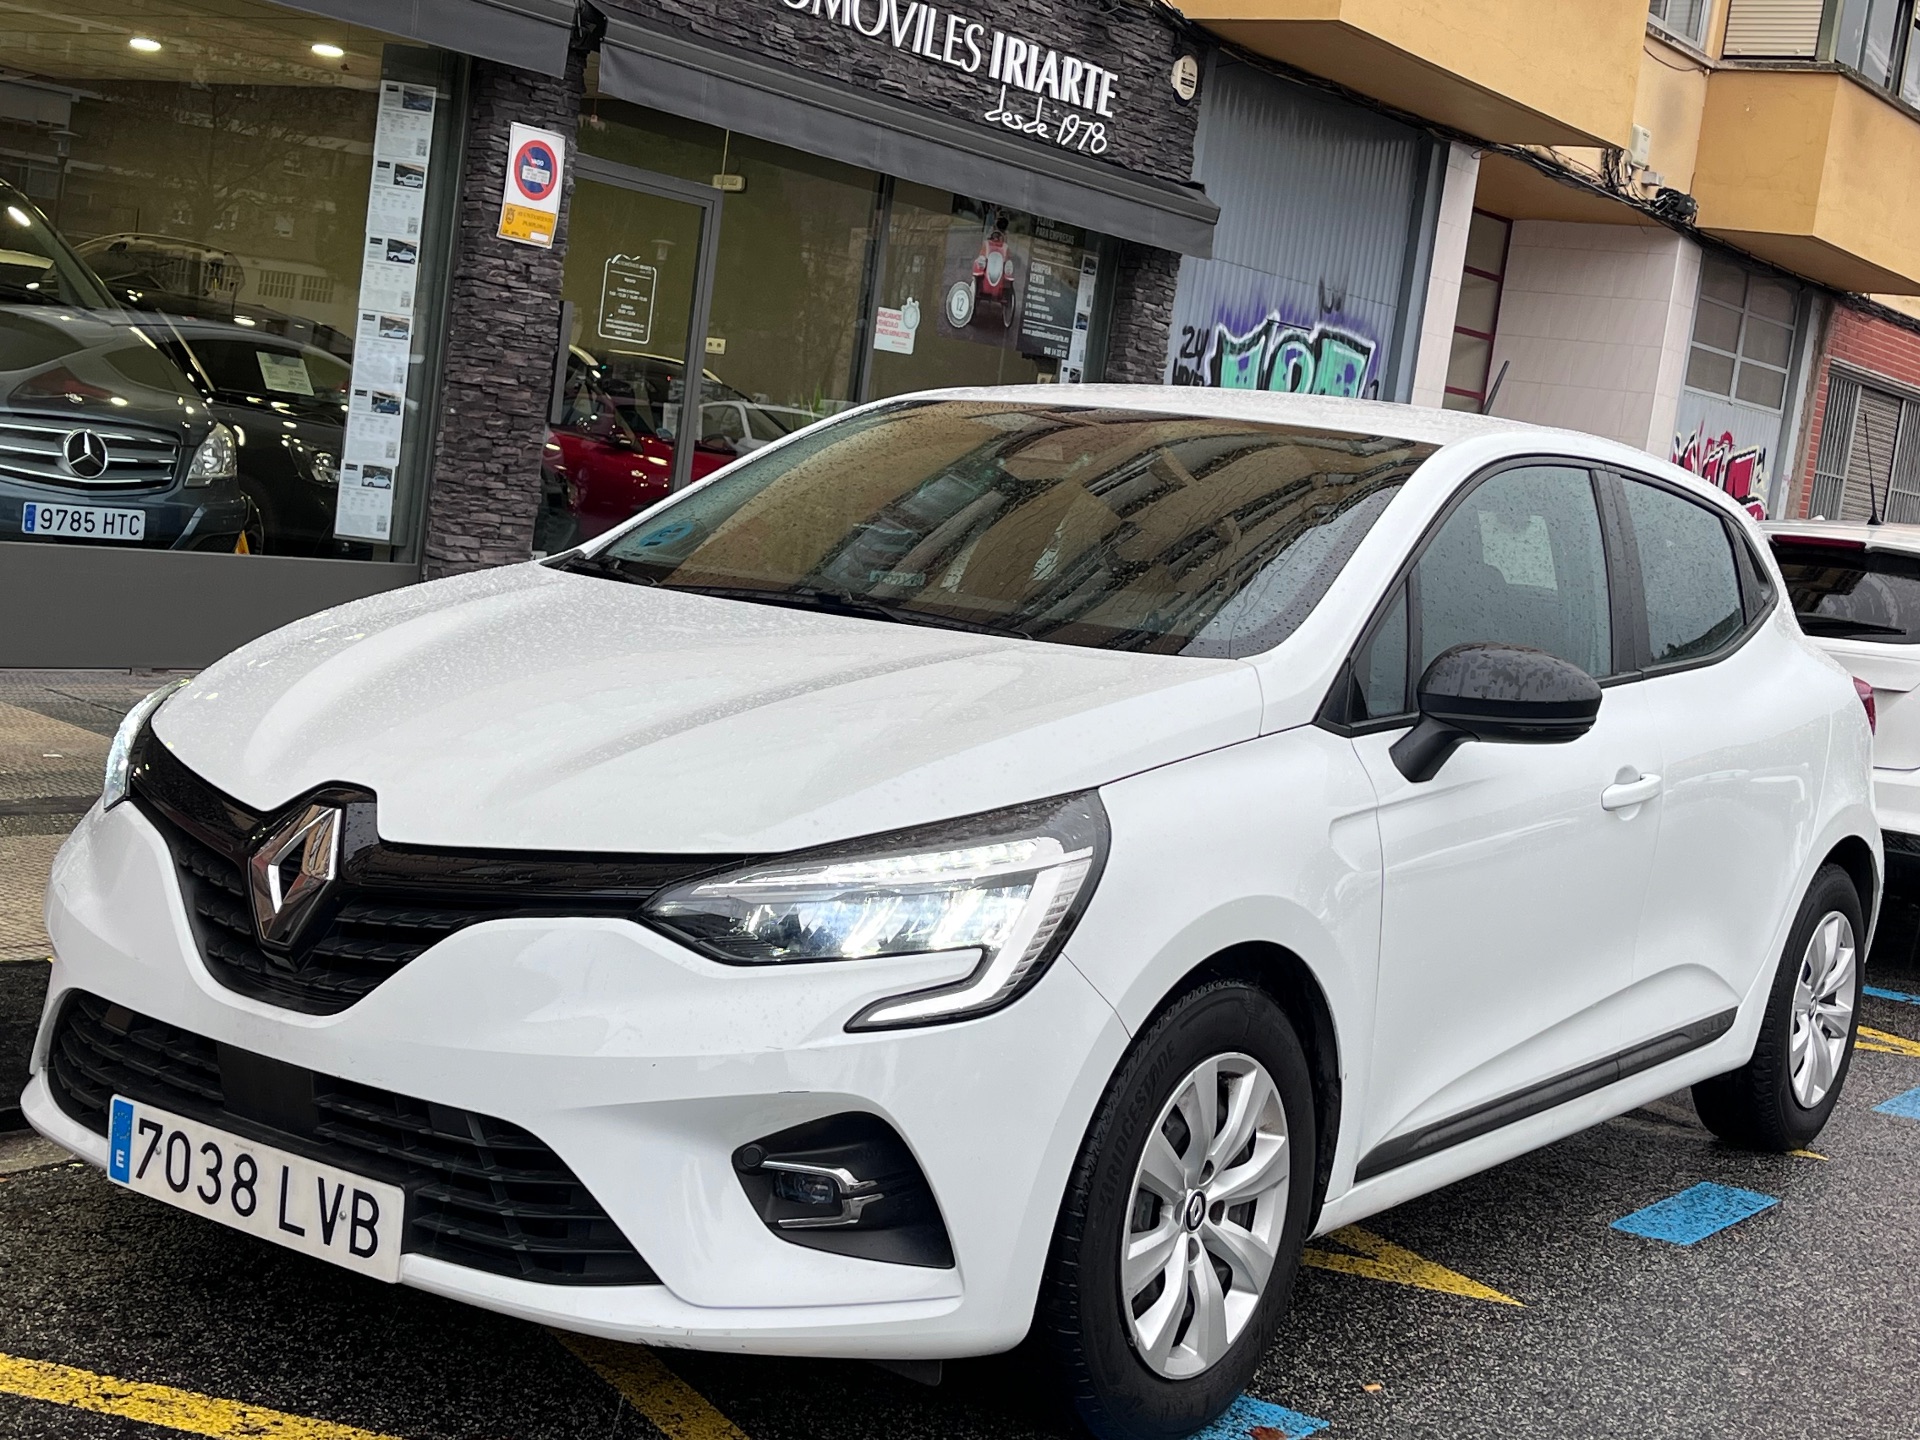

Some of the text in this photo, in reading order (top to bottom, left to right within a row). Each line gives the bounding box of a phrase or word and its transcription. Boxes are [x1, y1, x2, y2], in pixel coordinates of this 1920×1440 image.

[988, 31, 1119, 119] IRIARTE
[984, 84, 1108, 154] desde 1978
[39, 507, 96, 534] 9785
[102, 512, 141, 536] HTC
[114, 1116, 381, 1260] E 7038 LVB
